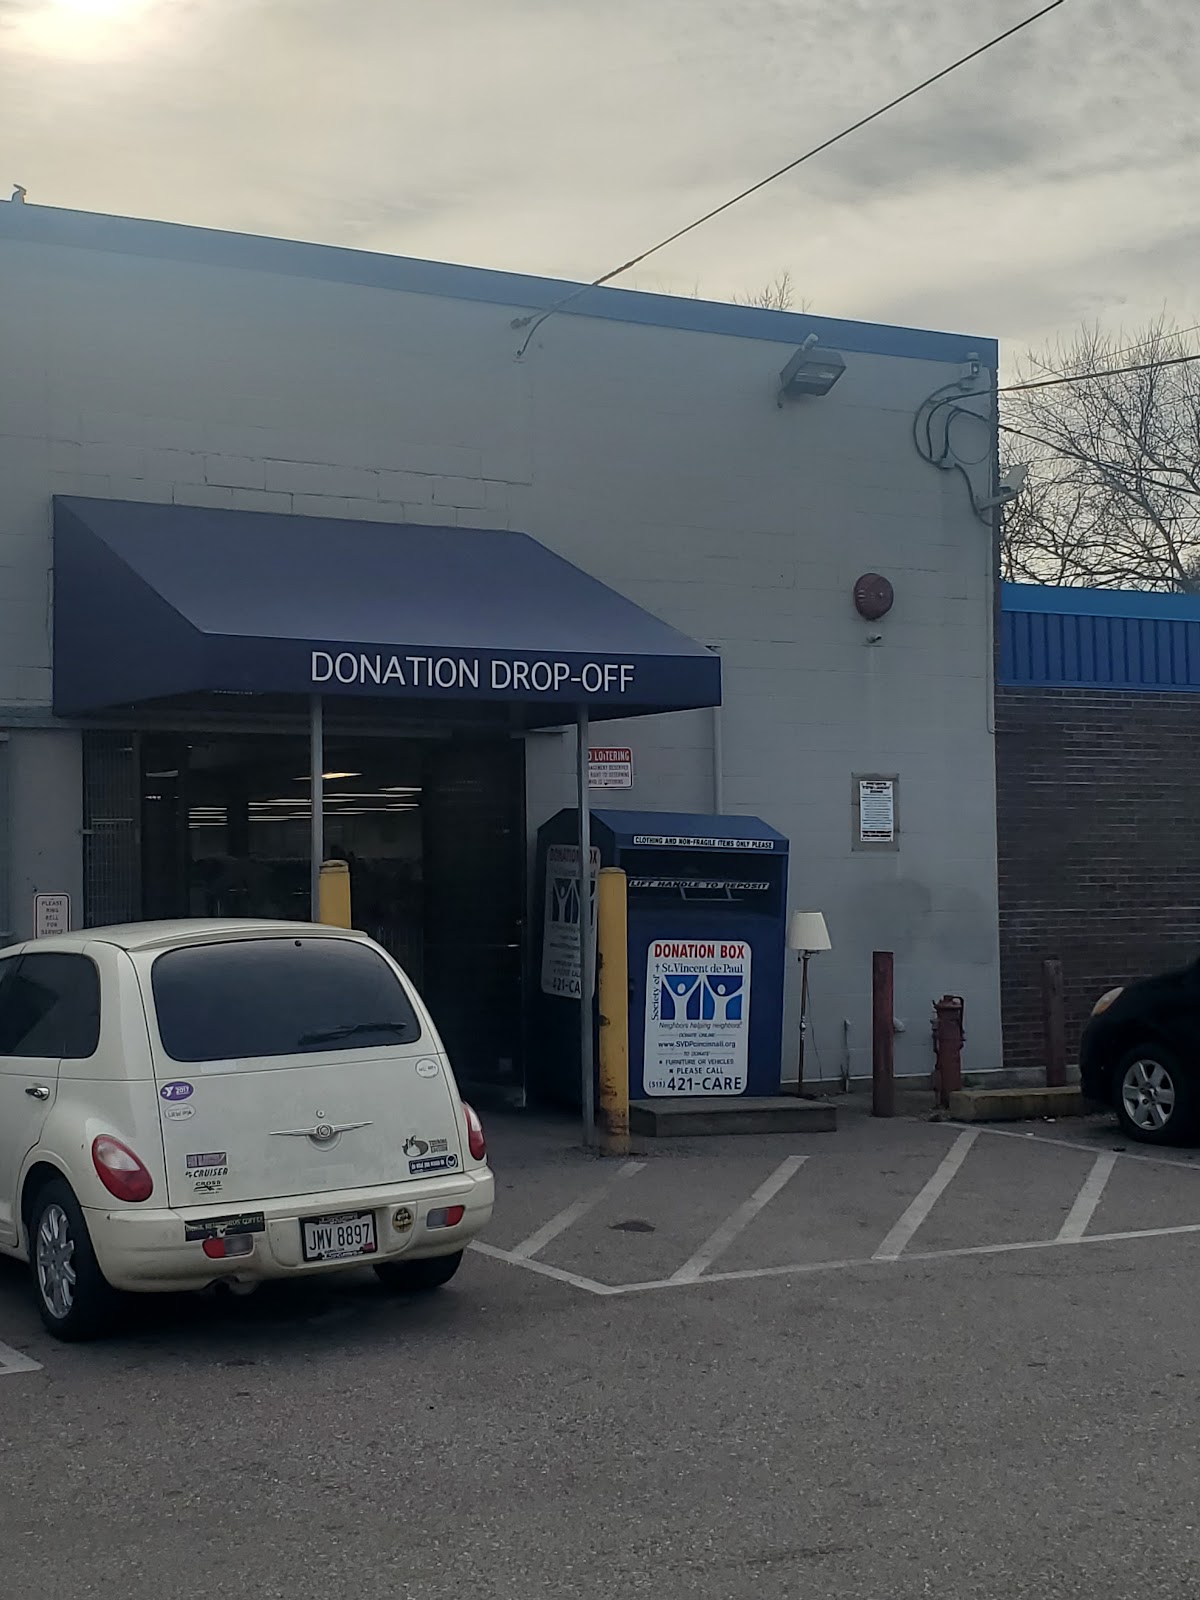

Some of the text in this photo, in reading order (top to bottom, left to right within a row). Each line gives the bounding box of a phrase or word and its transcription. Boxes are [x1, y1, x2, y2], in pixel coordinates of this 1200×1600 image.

[311, 651, 635, 692] DONATION DROP-OFF
[594, 751, 630, 762] LOITERING
[635, 836, 663, 844] CLOTHING
[678, 838, 716, 846] NON-FRAGILE
[654, 943, 744, 959] DONATION BOX
[710, 964, 722, 973] de
[723, 963, 744, 973] Paul
[651, 987, 661, 1021] Society
[676, 1067, 724, 1075] PLEASE CALL
[667, 1076, 742, 1091] 421-CARE
[193, 1167, 229, 1177] CRUISER
[309, 1223, 370, 1250] JMV 8897
